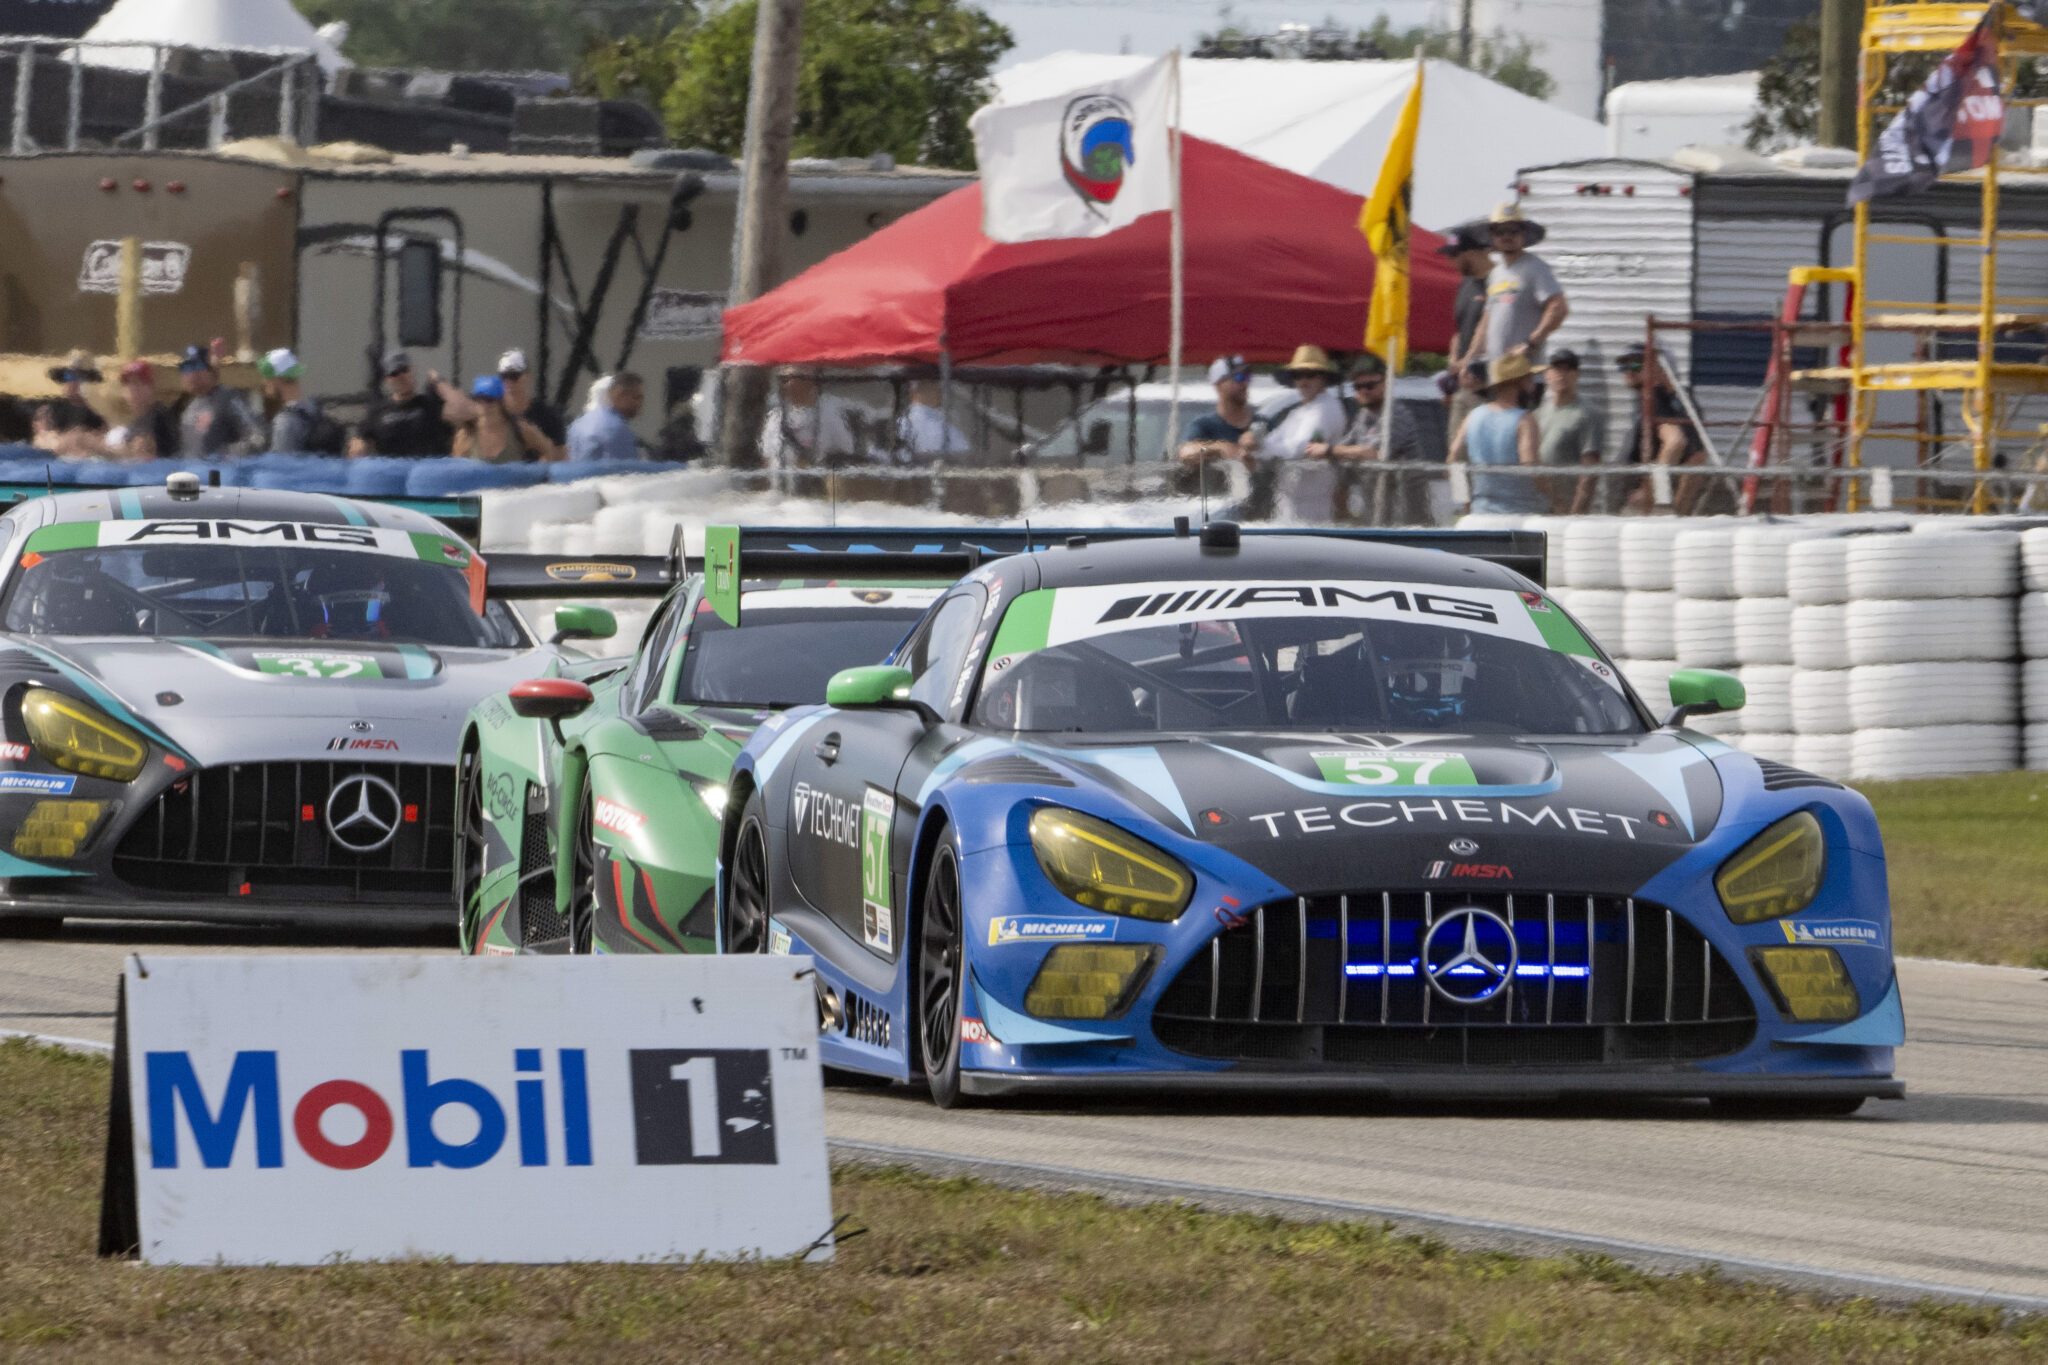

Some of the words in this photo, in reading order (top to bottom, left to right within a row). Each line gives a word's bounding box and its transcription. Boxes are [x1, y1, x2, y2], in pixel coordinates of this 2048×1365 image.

[126, 521, 378, 548] AMG
[1224, 586, 1499, 624] AMG
[277, 658, 364, 678] 32
[349, 738, 399, 751] IMSA
[0, 776, 66, 790] MICHELIN
[1344, 758, 1446, 785] 57
[810, 789, 862, 848] TECHEMET
[1249, 800, 1641, 839] TECHEMET
[865, 815, 889, 900] 57
[1452, 863, 1514, 879] IMSA
[1021, 923, 1106, 935] MICHELIN
[1813, 926, 1877, 939] MICHELIN
[144, 1048, 594, 1170] Mobil
[669, 1056, 722, 1157] 1
